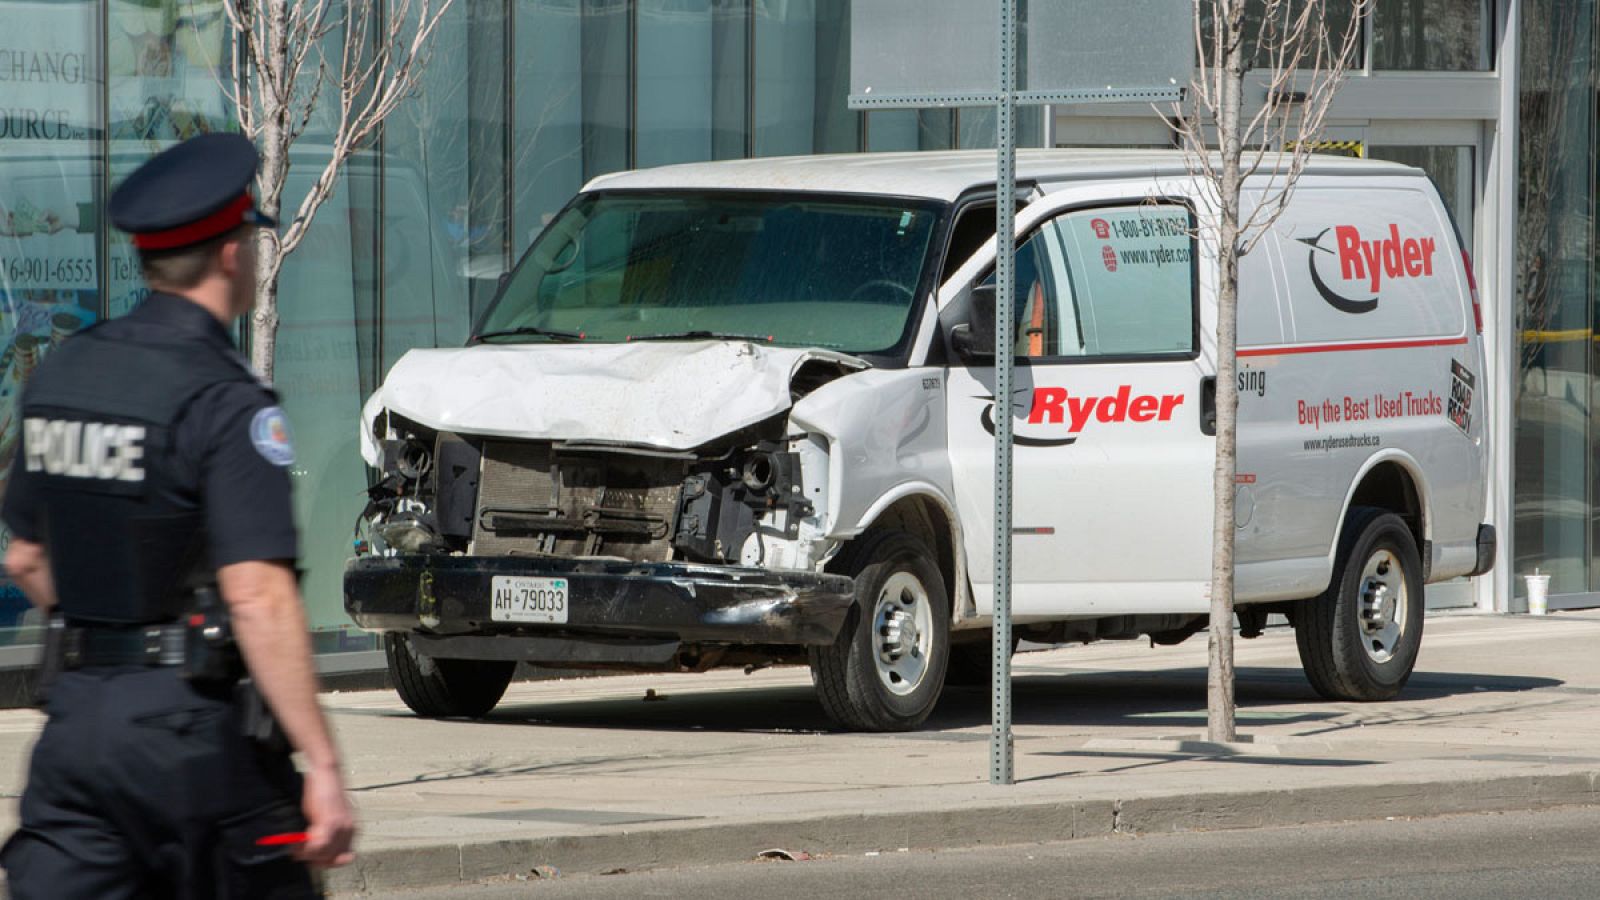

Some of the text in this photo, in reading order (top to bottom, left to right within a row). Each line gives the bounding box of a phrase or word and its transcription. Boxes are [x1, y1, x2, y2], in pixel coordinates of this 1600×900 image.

[1120, 244, 1191, 268] www.ryder.co
[1335, 223, 1436, 293] Ryder
[1237, 363, 1266, 396] sing
[1028, 385, 1184, 433] Ryder
[1297, 390, 1442, 430] Buy the Best Used Trucks
[24, 418, 146, 482] POLICE
[1303, 434, 1381, 450] www.ryderusedtrucks.ca
[495, 588, 564, 611] AH 79033
